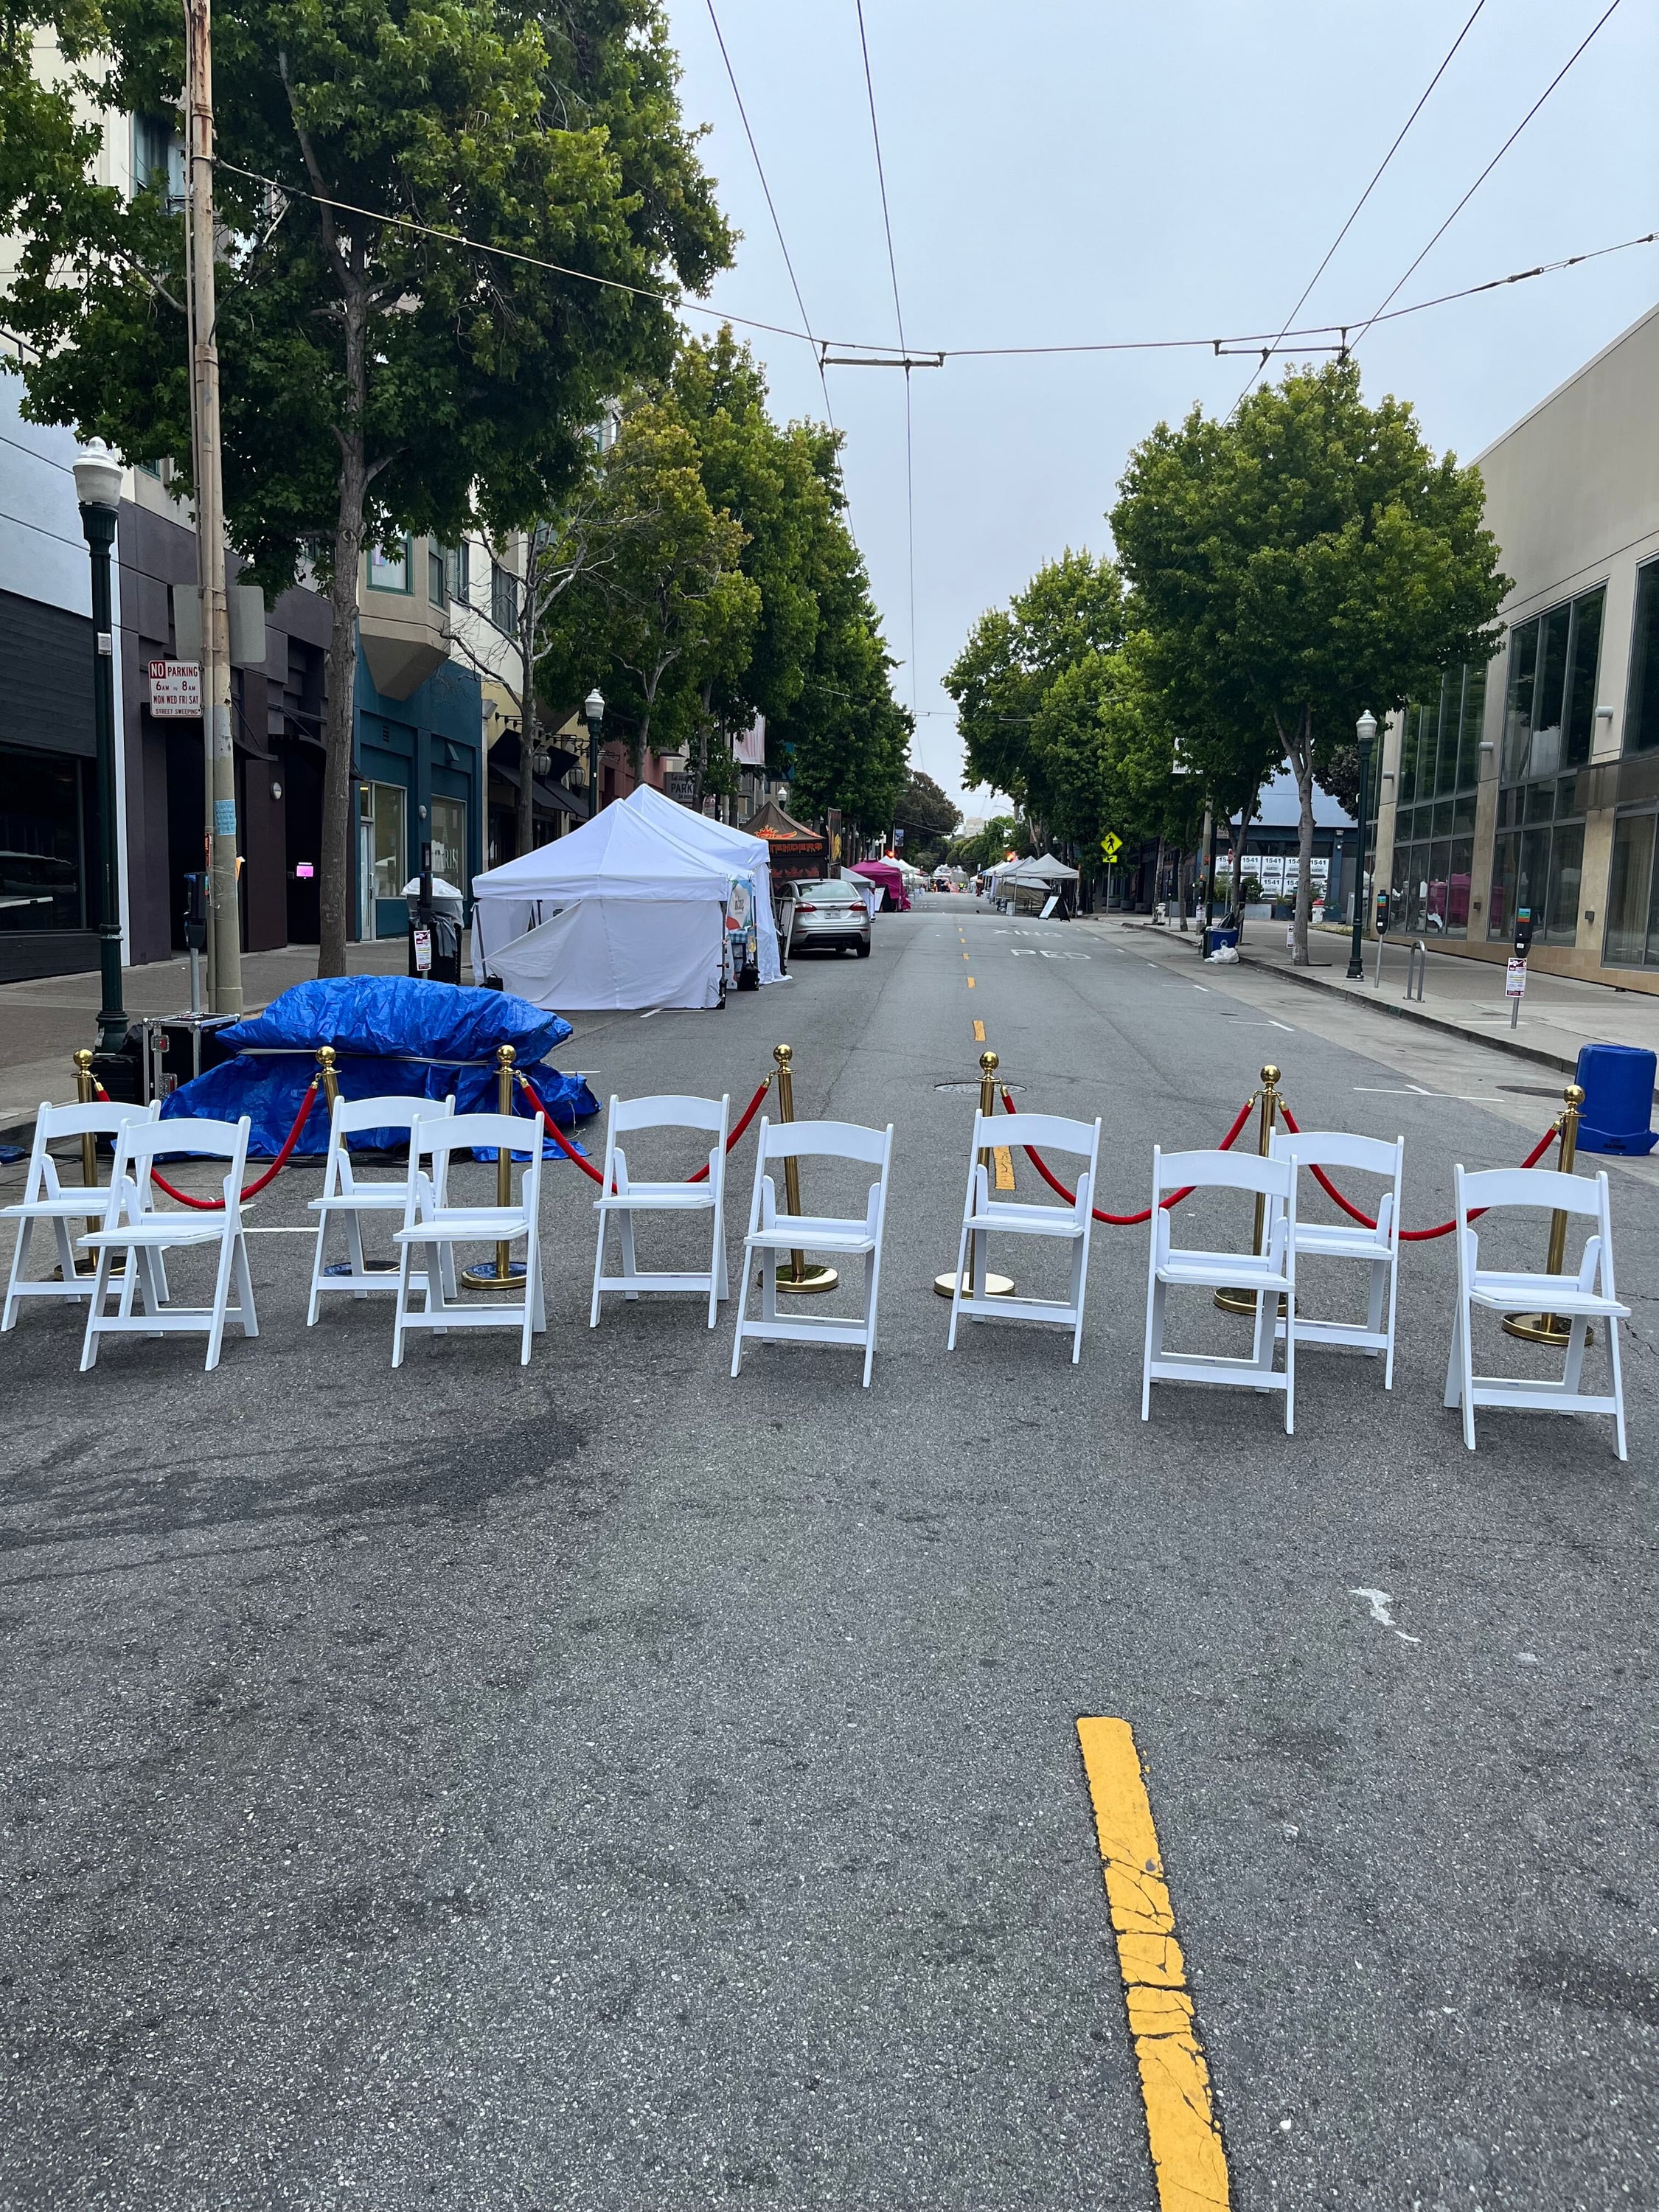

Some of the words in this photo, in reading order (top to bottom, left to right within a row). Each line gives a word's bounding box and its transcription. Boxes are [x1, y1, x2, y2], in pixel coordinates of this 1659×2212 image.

[150, 663, 164, 677] NO
[167, 667, 198, 677] PARKING
[153, 695, 165, 704] MON
[167, 695, 177, 704] WED
[178, 695, 187, 704] FRI
[189, 695, 198, 704] SAT
[433, 849, 458, 869] PARIS
[991, 929, 1063, 938] XING
[1010, 949, 1091, 959] PED
